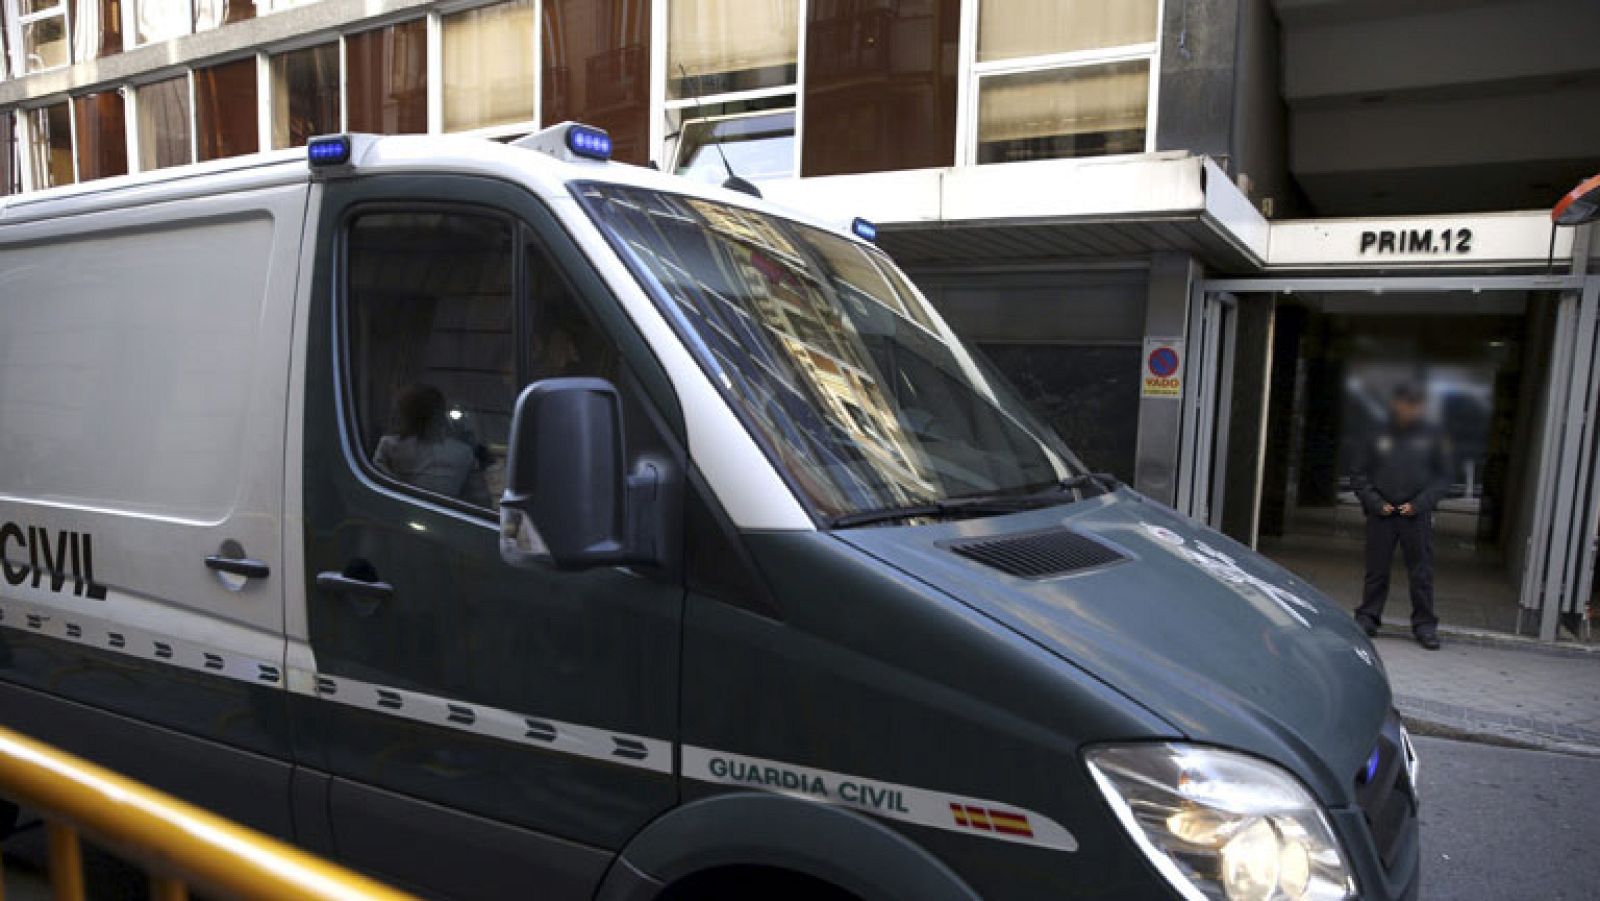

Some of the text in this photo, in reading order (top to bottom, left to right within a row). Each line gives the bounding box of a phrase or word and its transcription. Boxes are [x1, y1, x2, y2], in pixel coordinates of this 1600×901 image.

[1360, 229, 1472, 253] PRIM.12
[0, 522, 107, 600] CIVIL
[709, 758, 909, 813] GUARDIA CIVIL
